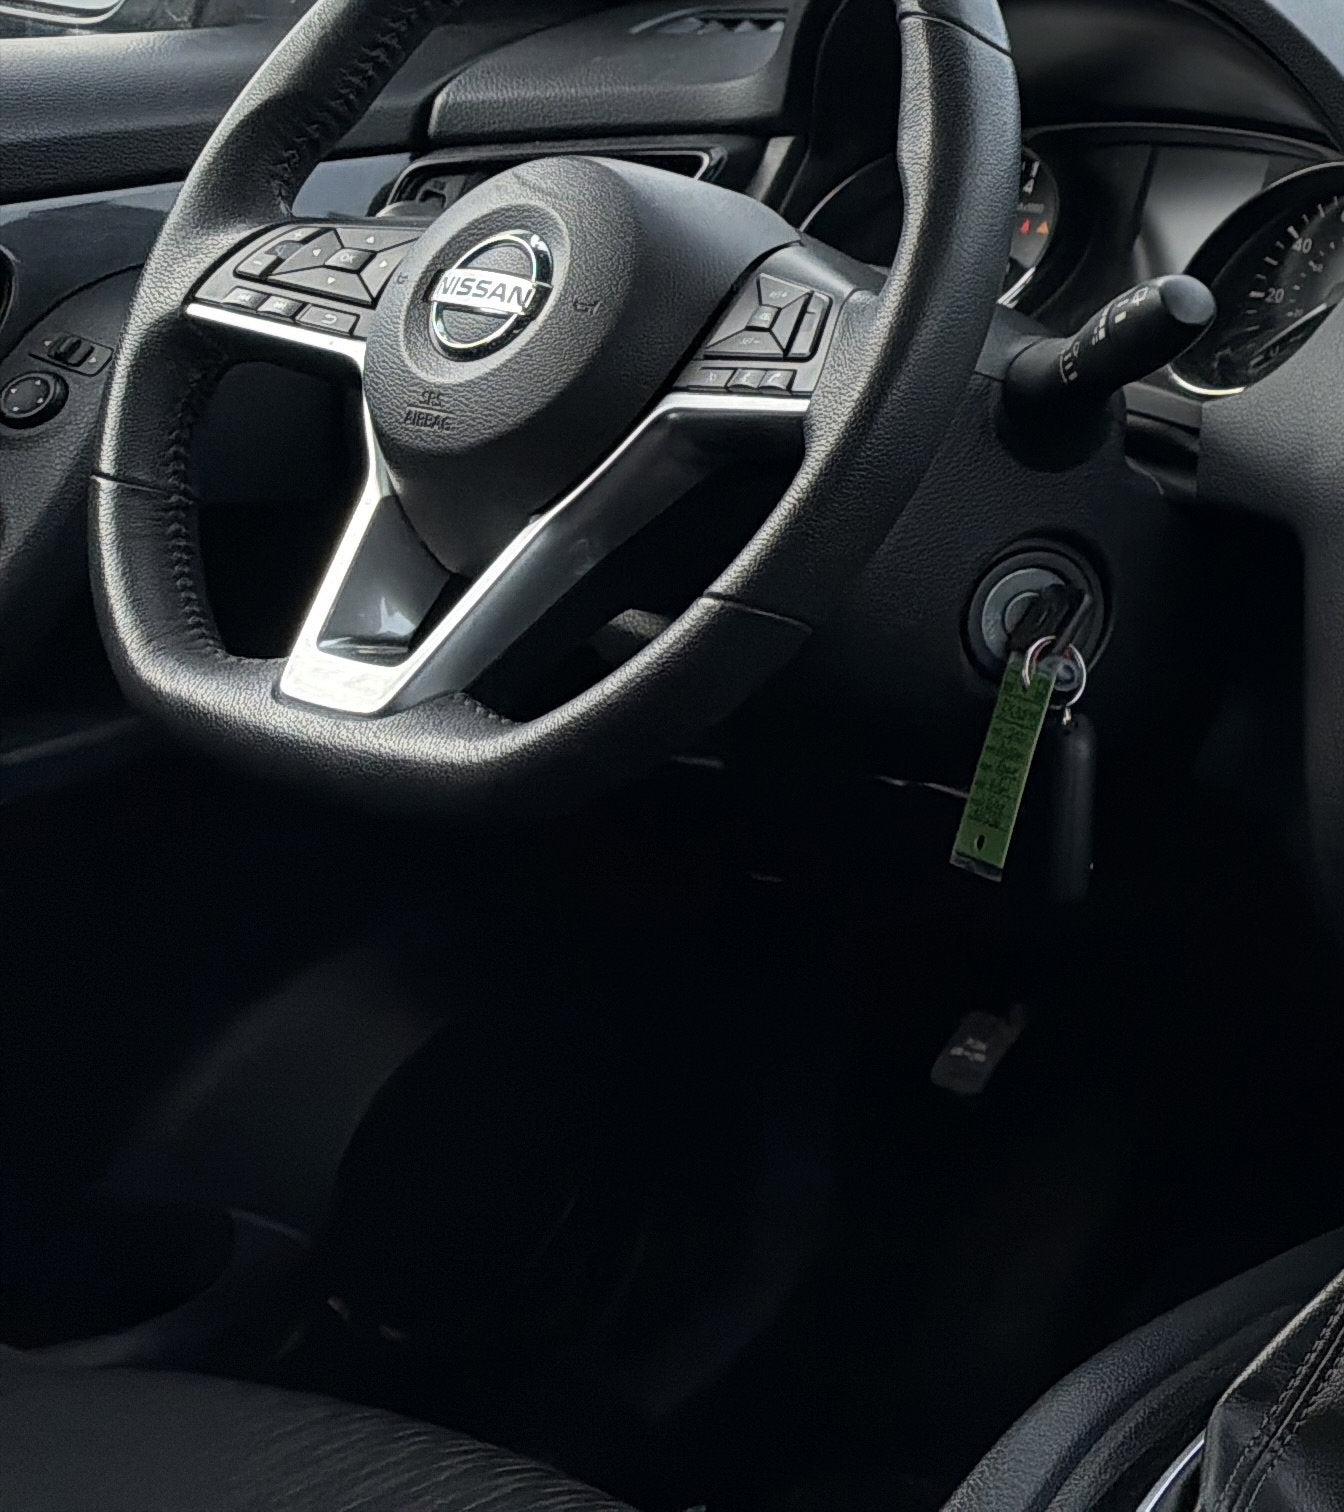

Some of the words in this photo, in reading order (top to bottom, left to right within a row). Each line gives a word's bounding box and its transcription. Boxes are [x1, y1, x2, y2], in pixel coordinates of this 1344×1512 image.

[1291, 237, 1313, 255] 40
[439, 275, 534, 309] NISSAN
[1265, 287, 1285, 304] 20
